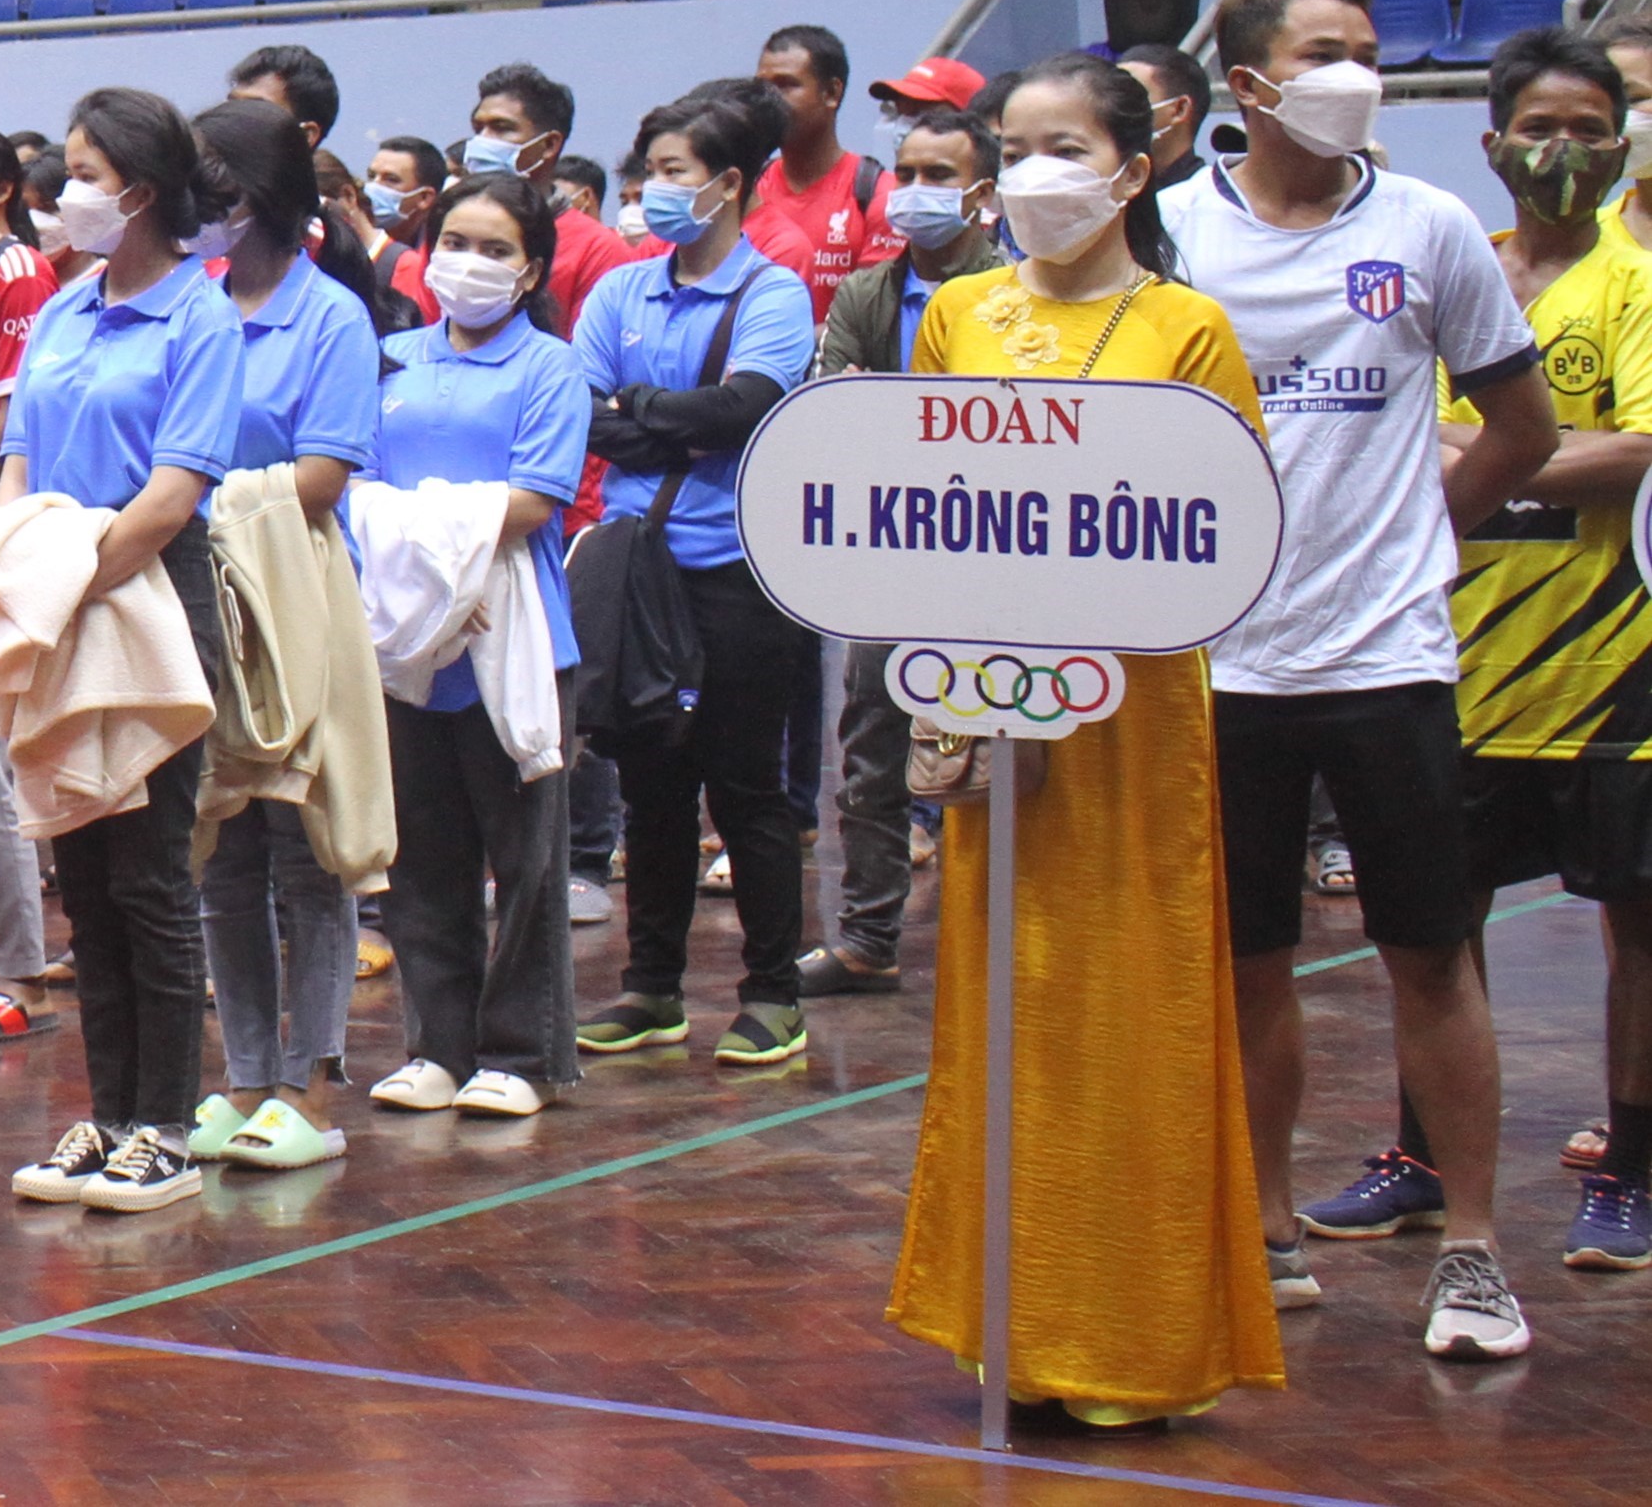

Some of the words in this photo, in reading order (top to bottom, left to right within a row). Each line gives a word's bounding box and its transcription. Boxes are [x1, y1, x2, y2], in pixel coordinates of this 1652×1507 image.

[918, 383, 1084, 446] ĐOÀN
[1299, 399, 1345, 412] Online
[869, 473, 1049, 557] KRÔNG
[1068, 480, 1218, 564] BÔNG
